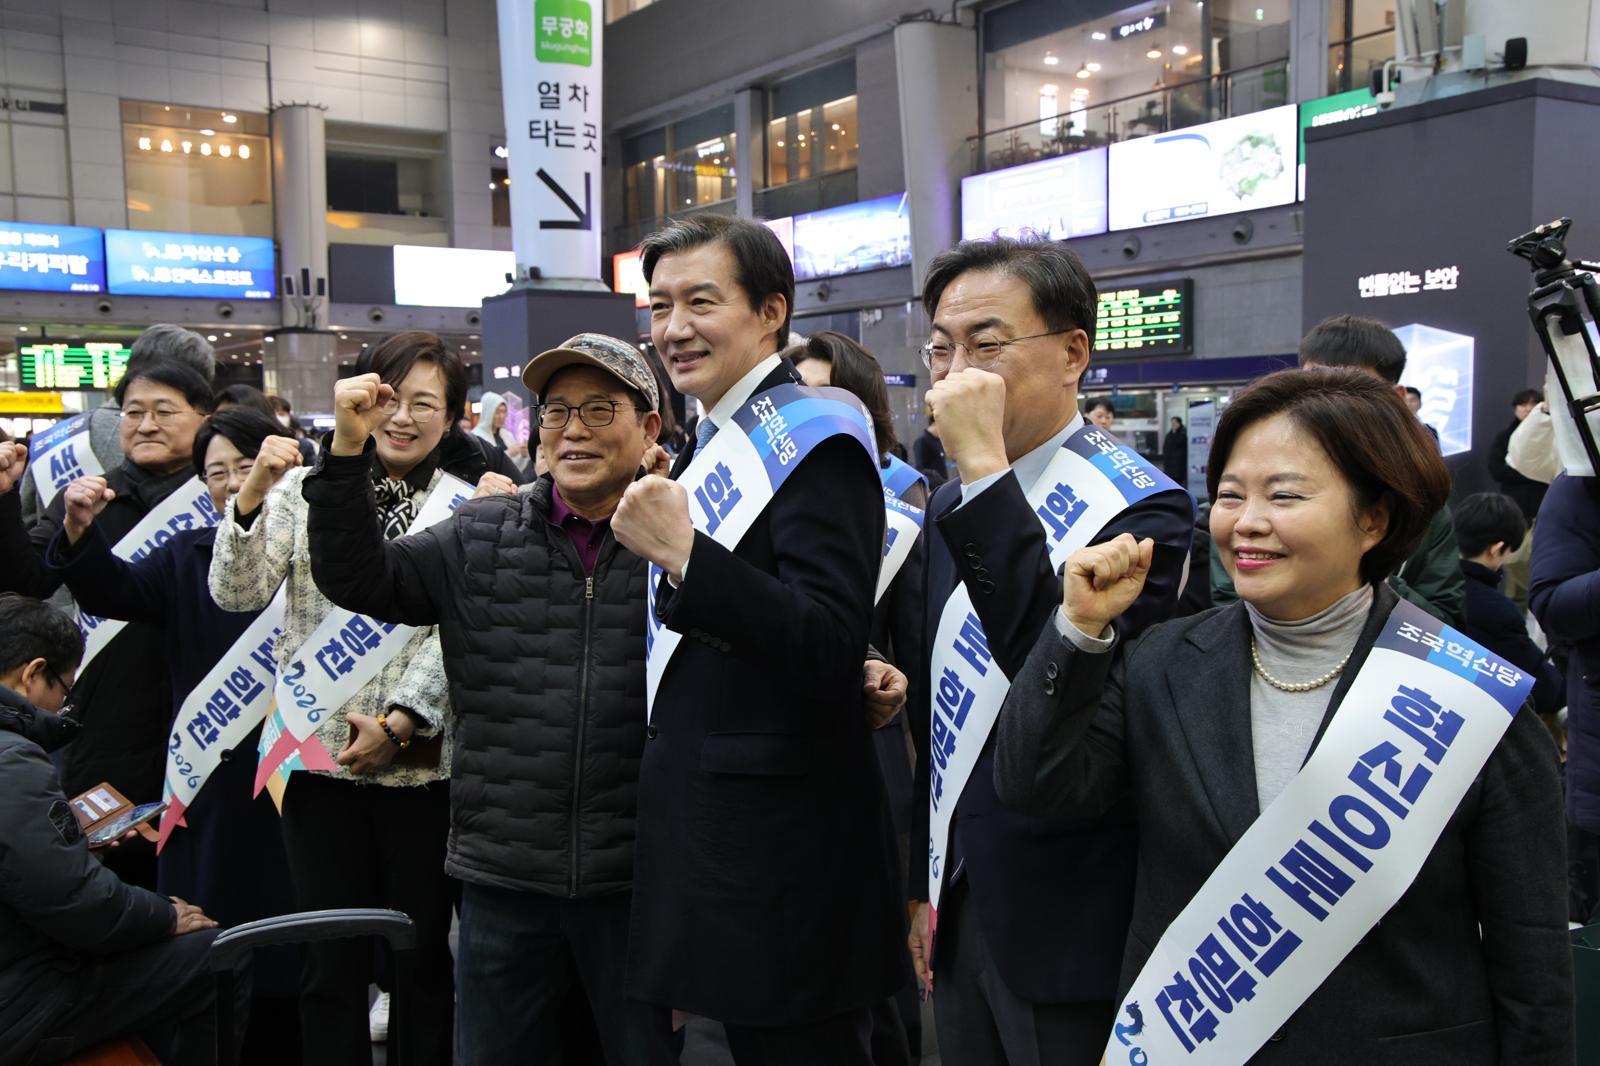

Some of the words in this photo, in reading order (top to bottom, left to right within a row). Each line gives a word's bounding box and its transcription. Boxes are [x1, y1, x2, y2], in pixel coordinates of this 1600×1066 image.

[541, 16, 589, 41] 무궁화
[537, 81, 589, 113] 열차
[1358, 270, 1421, 298] 빈틈없는
[1423, 265, 1459, 290] 보안
[751, 396, 798, 466] 조국혁신당
[1083, 430, 1156, 489] 조국혁신당
[315, 613, 397, 682] 망찬
[1396, 621, 1523, 688] 조국혁신당
[187, 665, 266, 751] 희망찬
[283, 659, 328, 723] 2026
[169, 732, 201, 789] 2026
[1264, 684, 1467, 923] 혁신으로
[1154, 892, 1304, 1055] 희망찬
